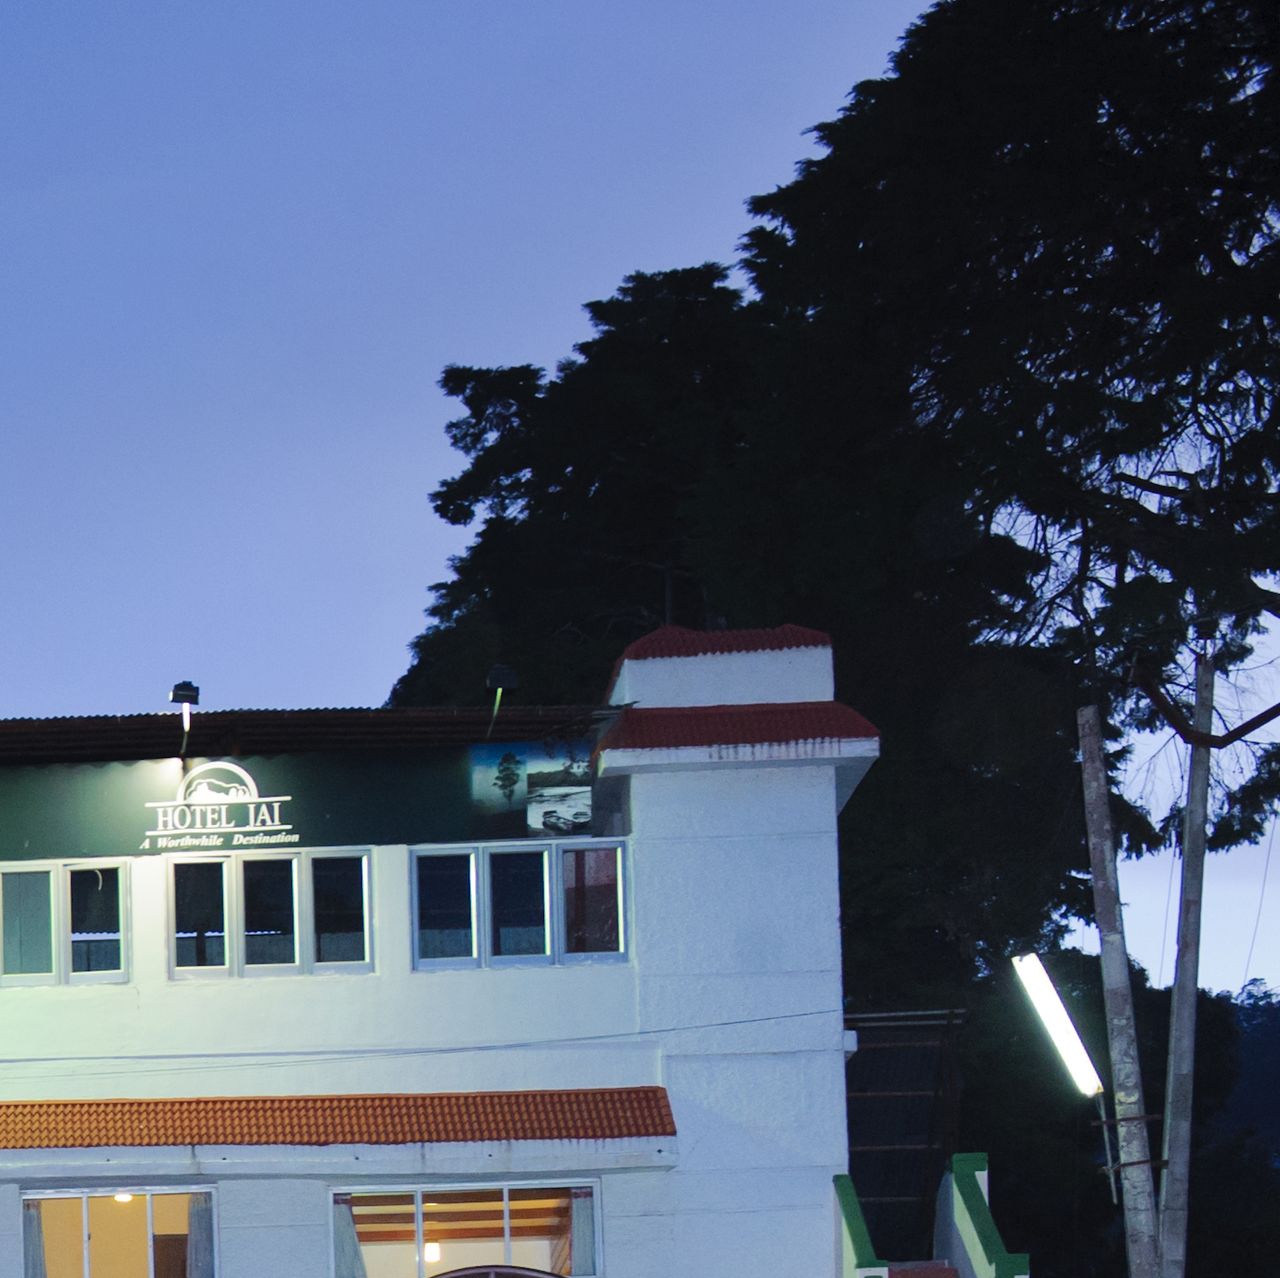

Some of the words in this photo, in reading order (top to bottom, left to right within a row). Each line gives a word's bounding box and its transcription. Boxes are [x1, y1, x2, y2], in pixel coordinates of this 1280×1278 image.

[156, 804, 235, 831] HOTEL
[246, 802, 282, 828] JAI
[139, 839, 151, 850] A
[156, 834, 224, 849] Worthwhile
[232, 831, 300, 846] Destination
